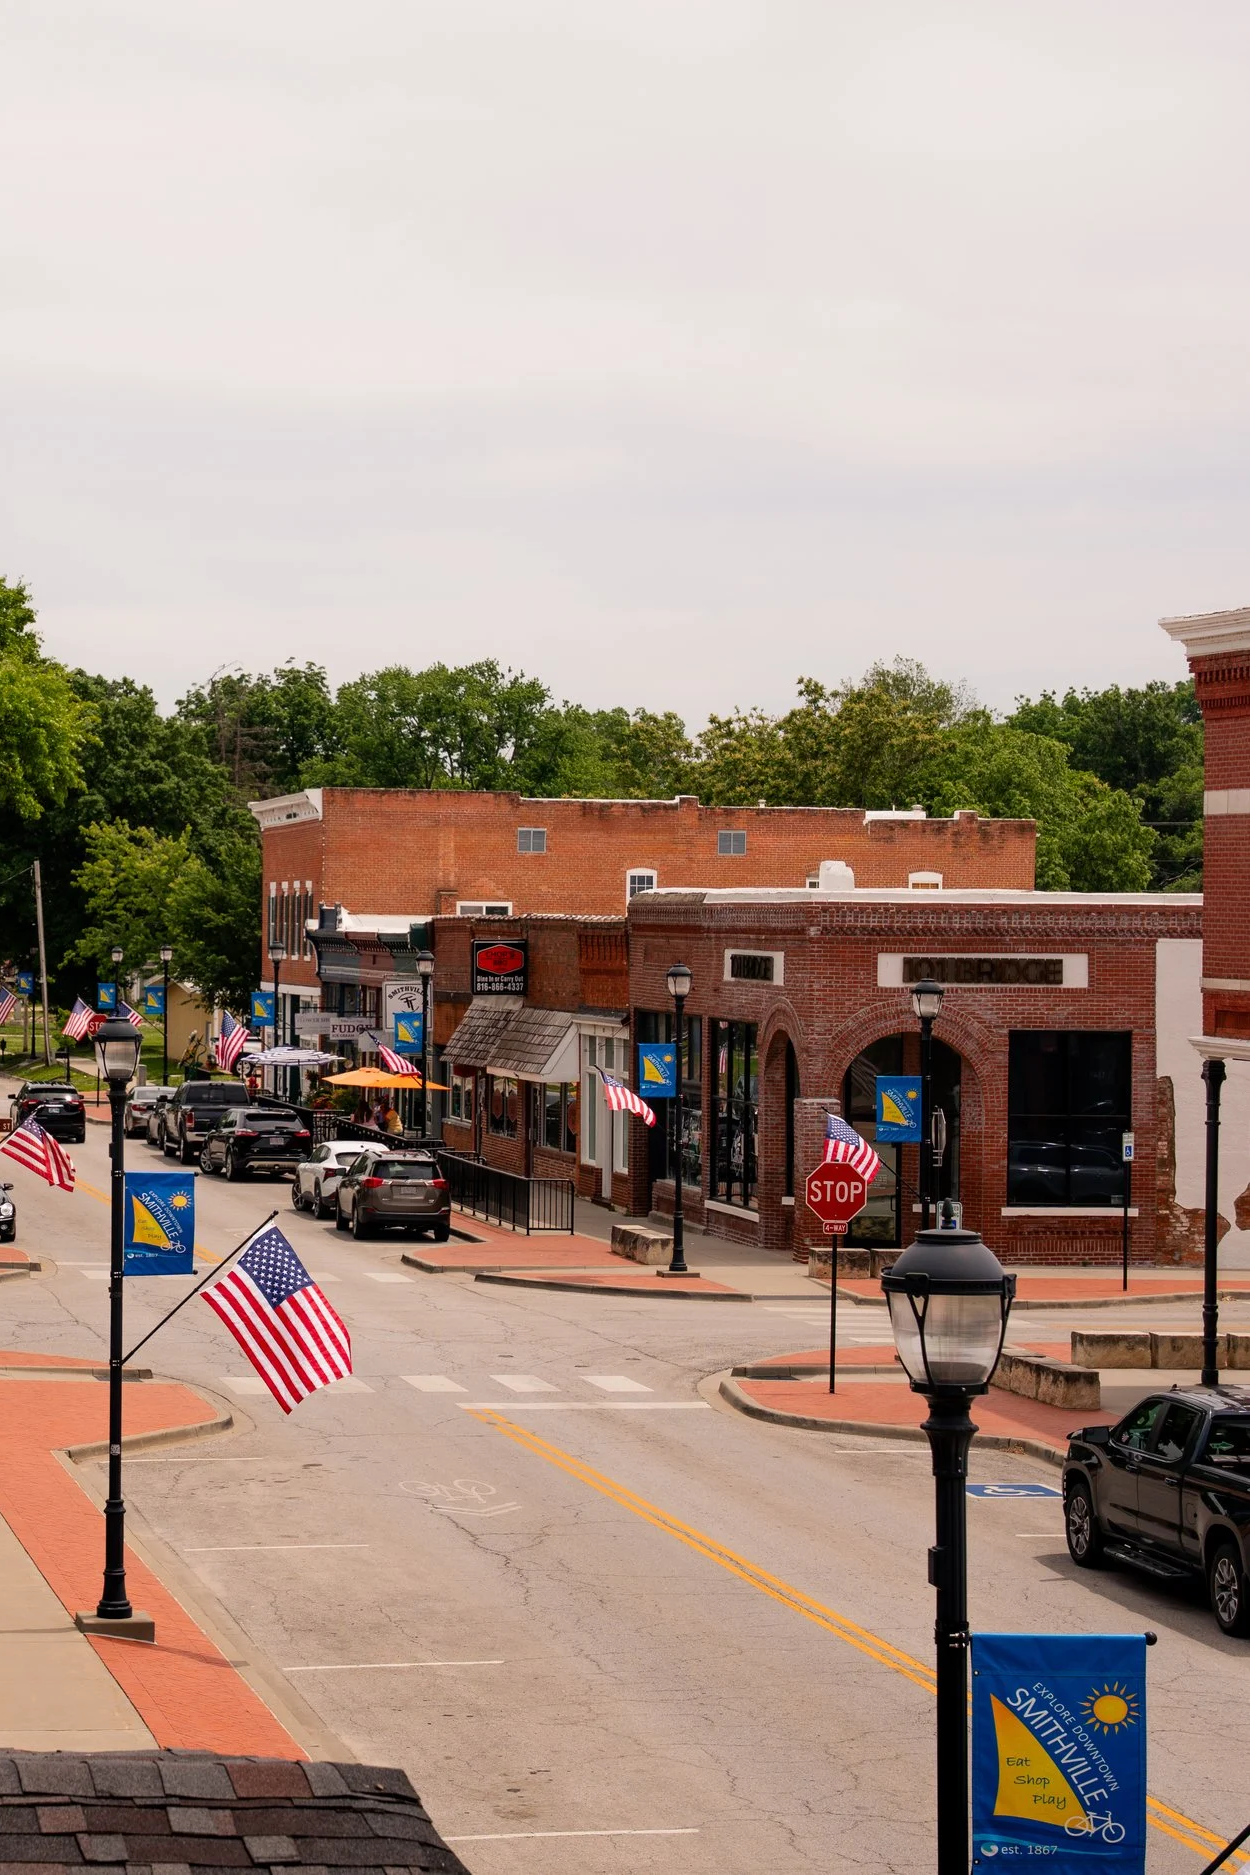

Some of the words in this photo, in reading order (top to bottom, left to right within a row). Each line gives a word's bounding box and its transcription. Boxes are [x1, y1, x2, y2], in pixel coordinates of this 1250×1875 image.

[955, 958, 1063, 984] BRIDGE
[388, 986, 424, 999] SMITHVILL
[810, 1180, 863, 1203] STOP
[138, 1192, 179, 1239] SMITHVILLE
[825, 1224, 846, 1232] 4-WAY
[1032, 1682, 1076, 1725] EXPLORE
[1072, 1725, 1120, 1791] DOWNTOWN
[1006, 1687, 1109, 1806] SMITHVILLE
[1006, 1757, 1031, 1767] Eat
[1013, 1775, 1050, 1789] Shop
[1032, 1793, 1067, 1810] Play
[1001, 1845, 1023, 1855] est.
[1027, 1845, 1058, 1855] 1867
